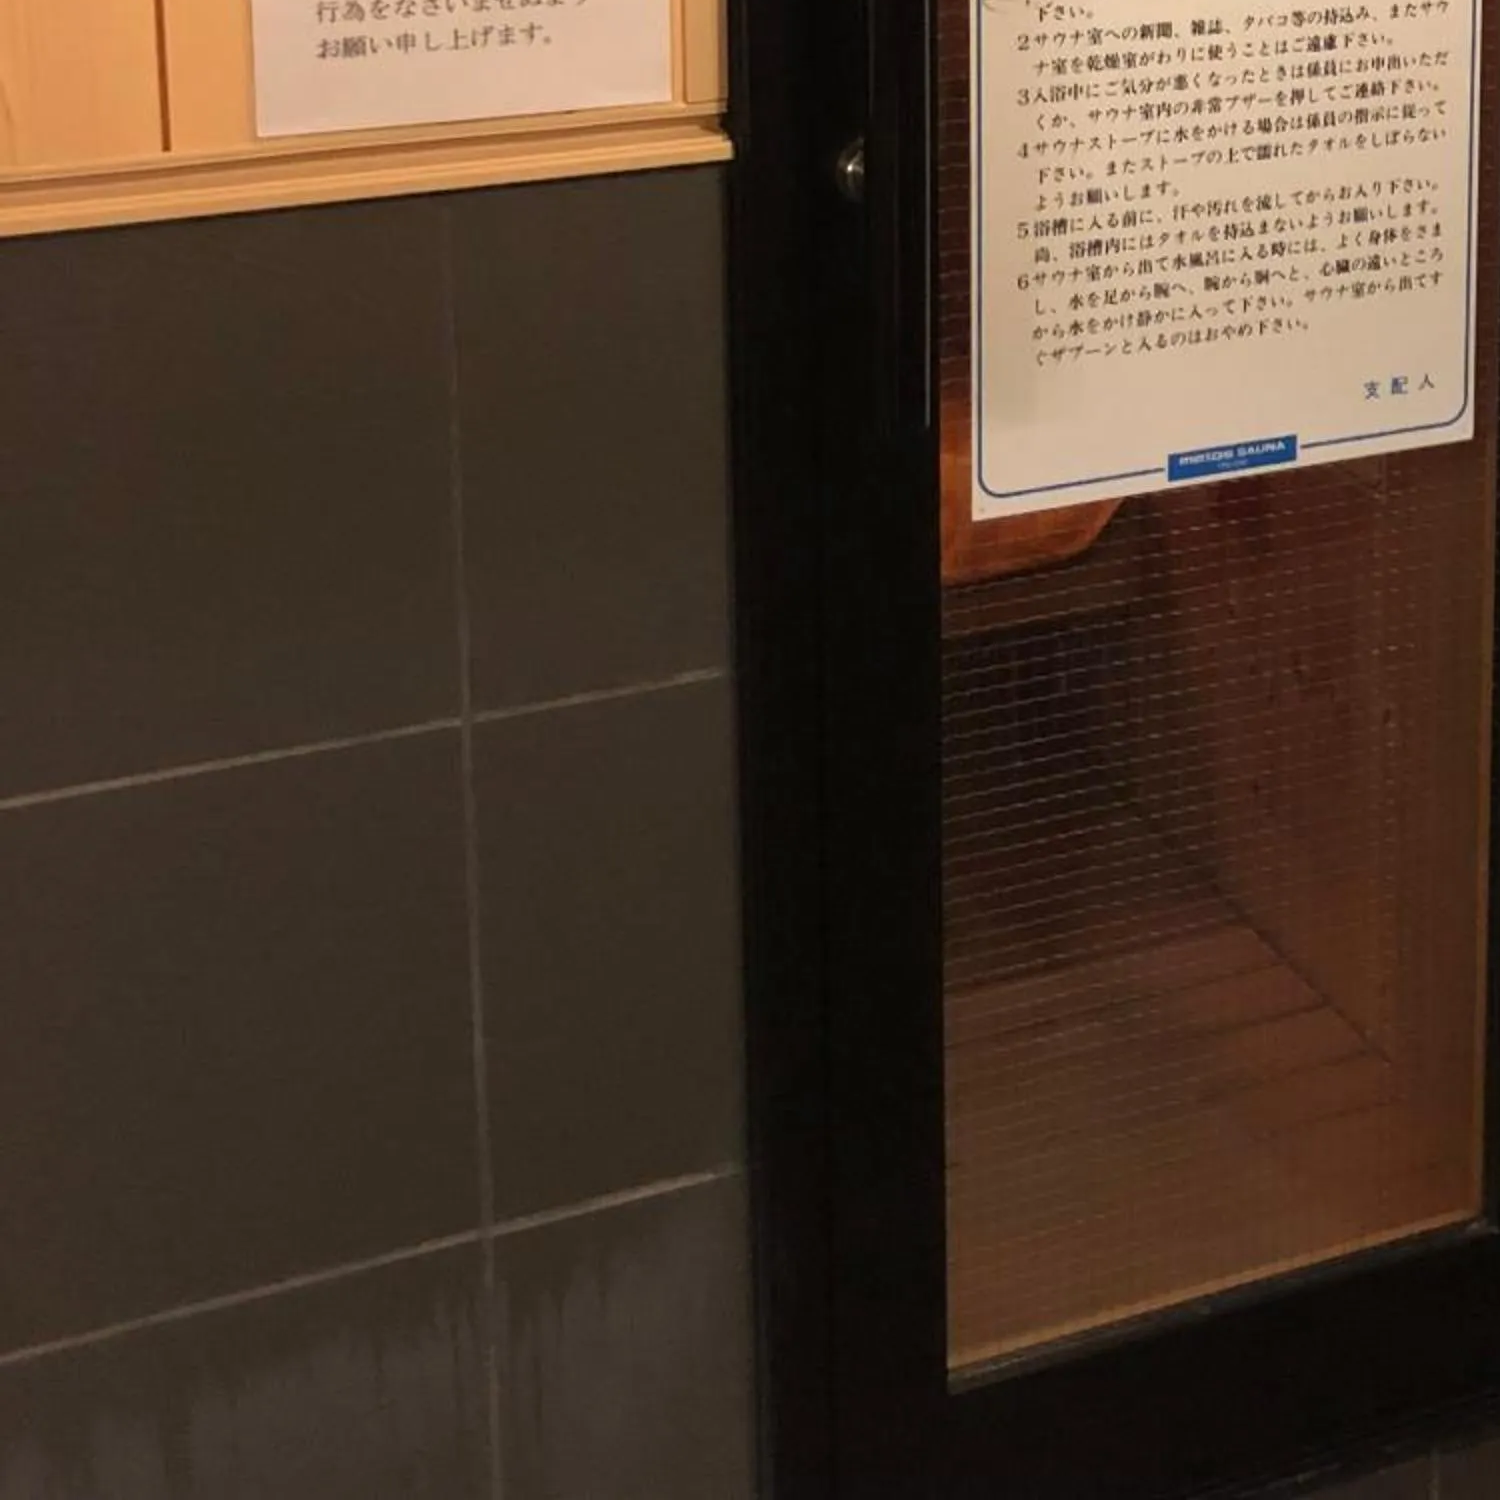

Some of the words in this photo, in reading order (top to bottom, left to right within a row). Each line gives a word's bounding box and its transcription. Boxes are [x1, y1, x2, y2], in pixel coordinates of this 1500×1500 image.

[1038, 2, 1093, 22] 下さい。
[316, 25, 554, 60] お願い申し上げます。
